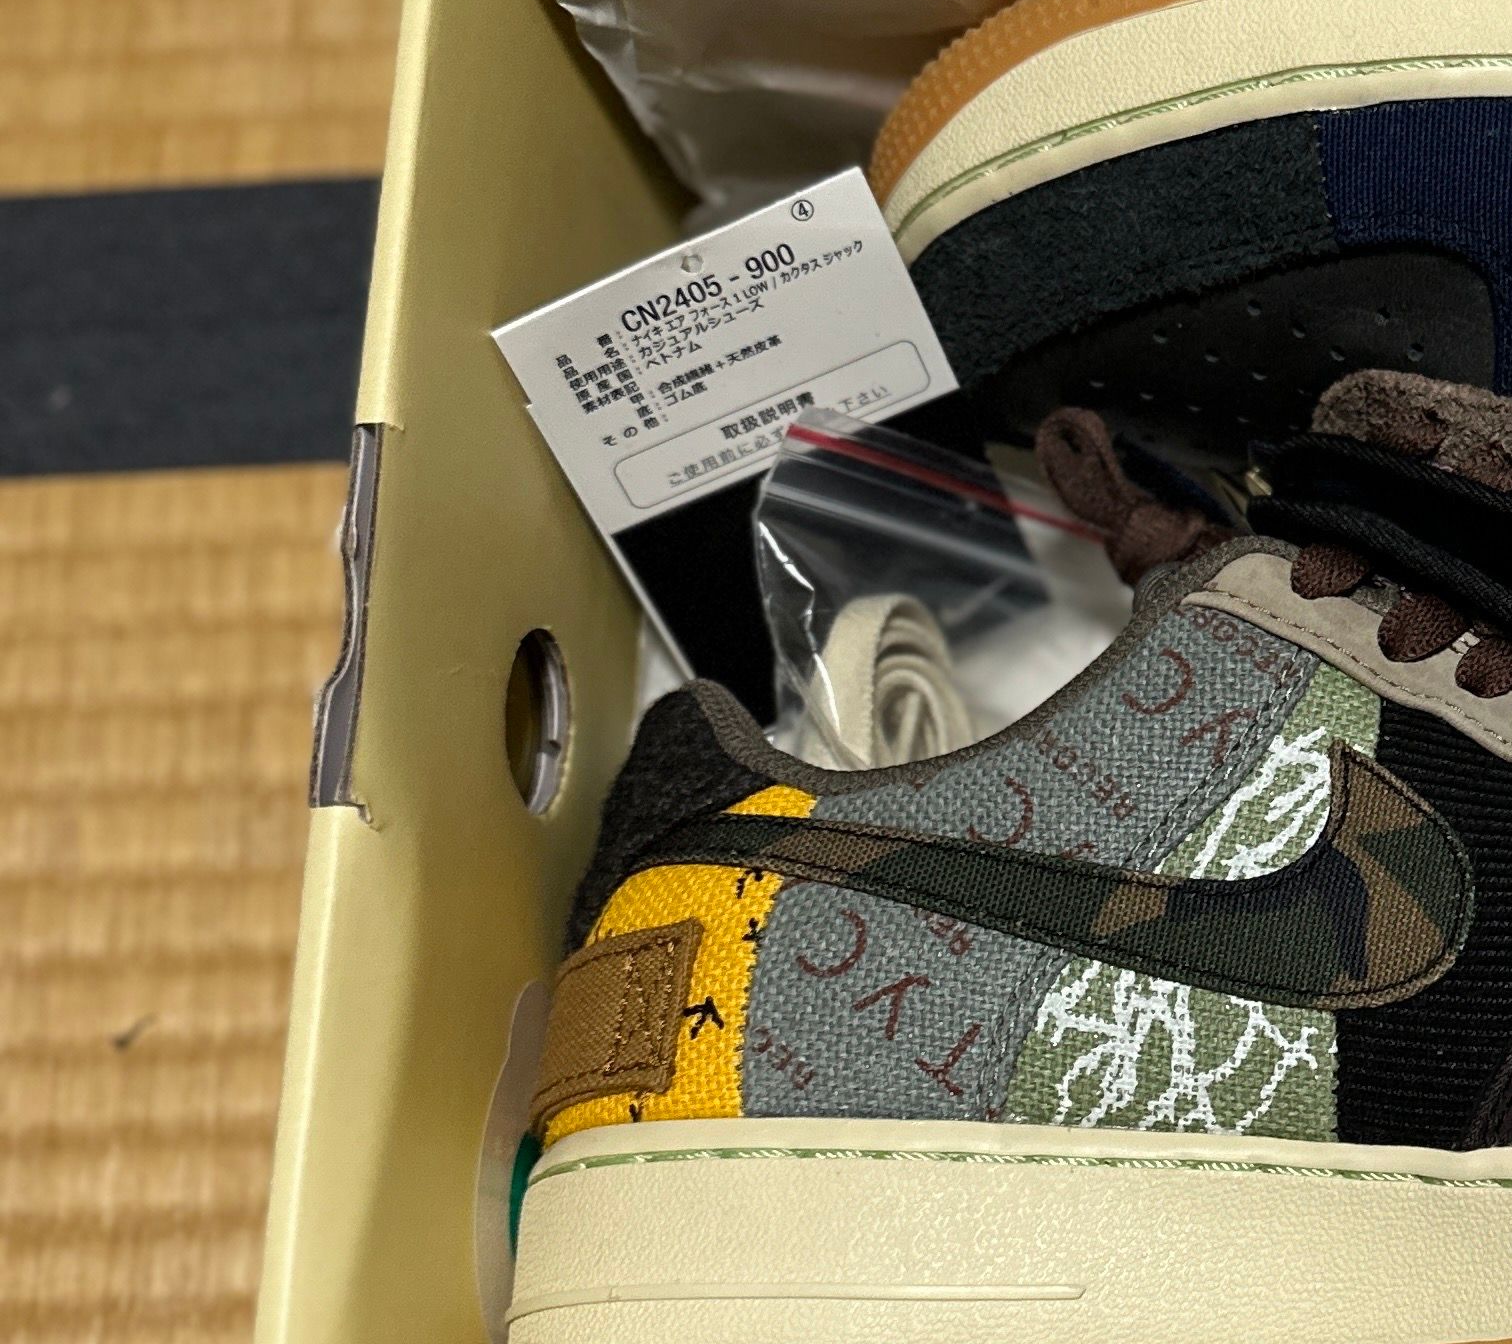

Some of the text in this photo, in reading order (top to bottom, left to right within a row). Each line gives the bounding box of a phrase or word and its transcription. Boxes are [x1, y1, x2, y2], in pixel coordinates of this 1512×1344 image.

[618, 273, 722, 332] CN2405
[742, 242, 795, 280] 900
[741, 280, 768, 299] LOW
